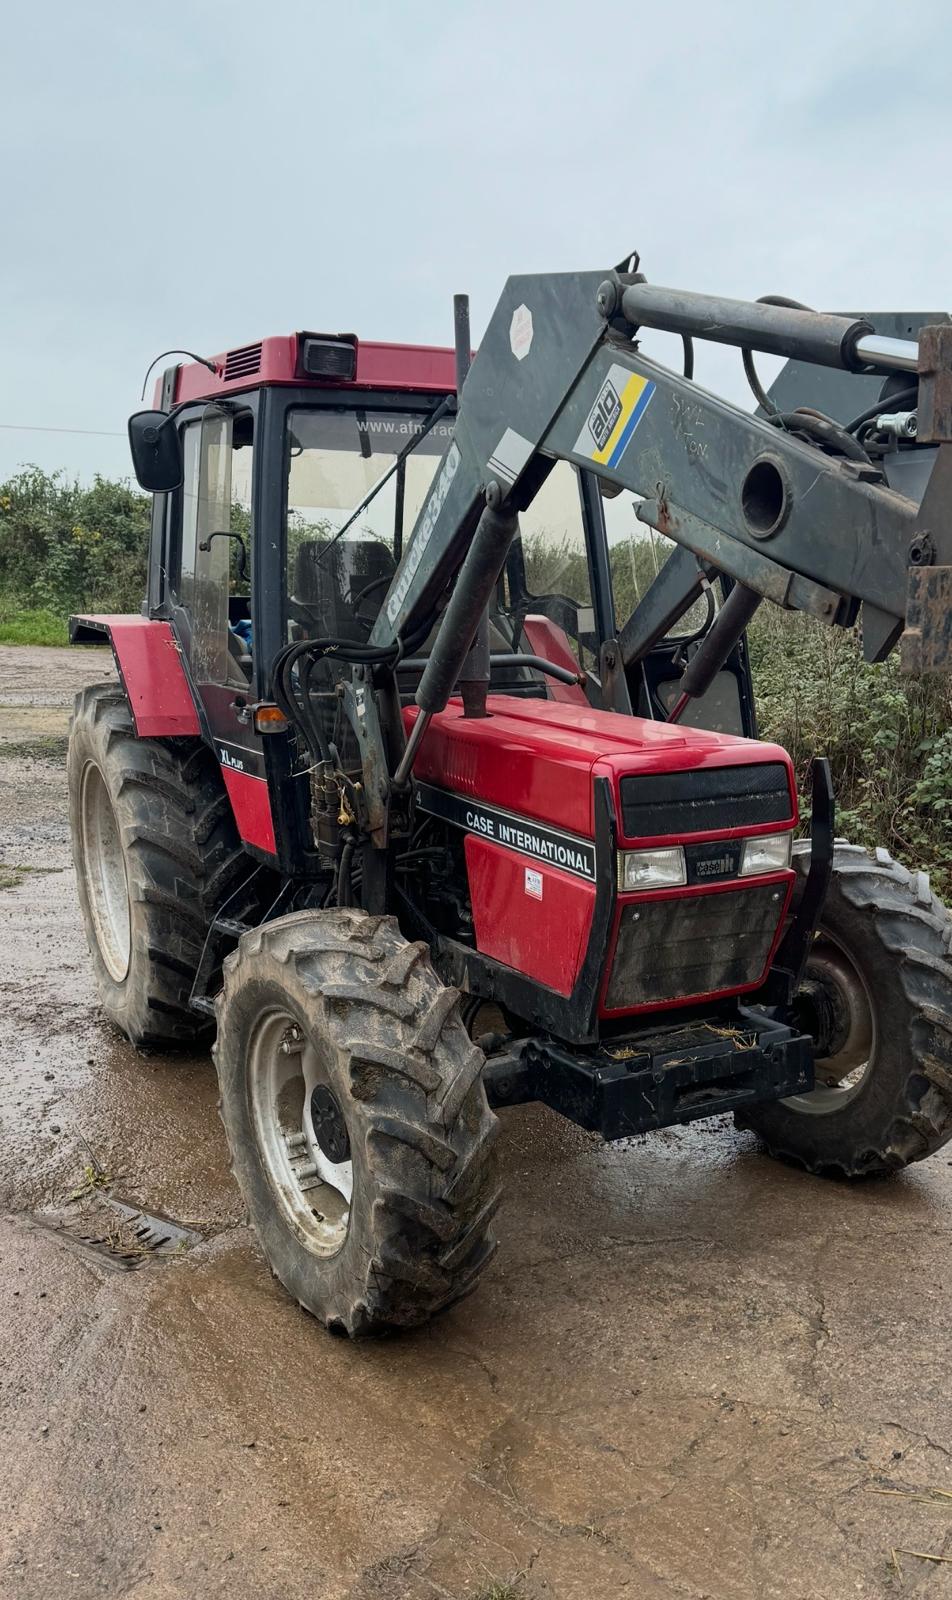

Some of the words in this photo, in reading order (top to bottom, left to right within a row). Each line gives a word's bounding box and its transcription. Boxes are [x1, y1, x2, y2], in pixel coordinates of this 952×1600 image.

[220, 748, 231, 765] XL
[466, 811, 494, 836] CASE
[499, 823, 592, 875] INTERNATIONAL
